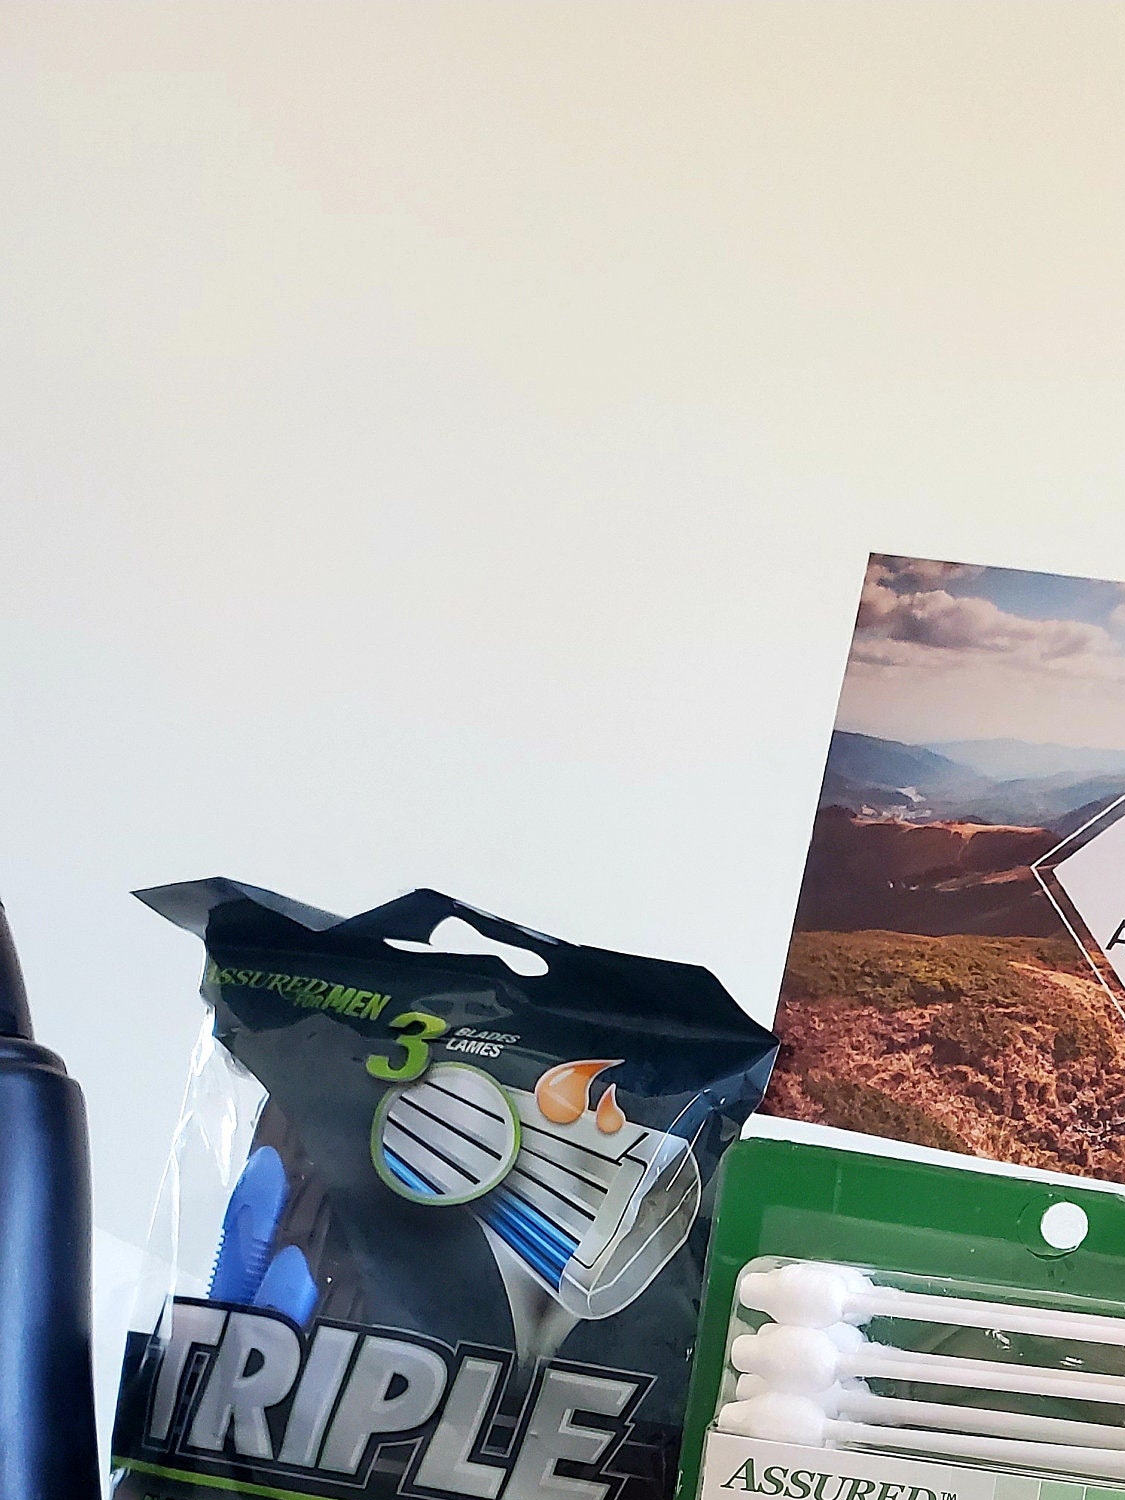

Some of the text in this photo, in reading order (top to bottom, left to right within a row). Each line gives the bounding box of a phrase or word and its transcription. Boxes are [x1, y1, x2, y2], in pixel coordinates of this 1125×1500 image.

[326, 984, 392, 1021] MEN
[365, 1010, 449, 1082] 3
[446, 1038, 504, 1058] LAMES
[454, 1027, 520, 1044] BLADES
